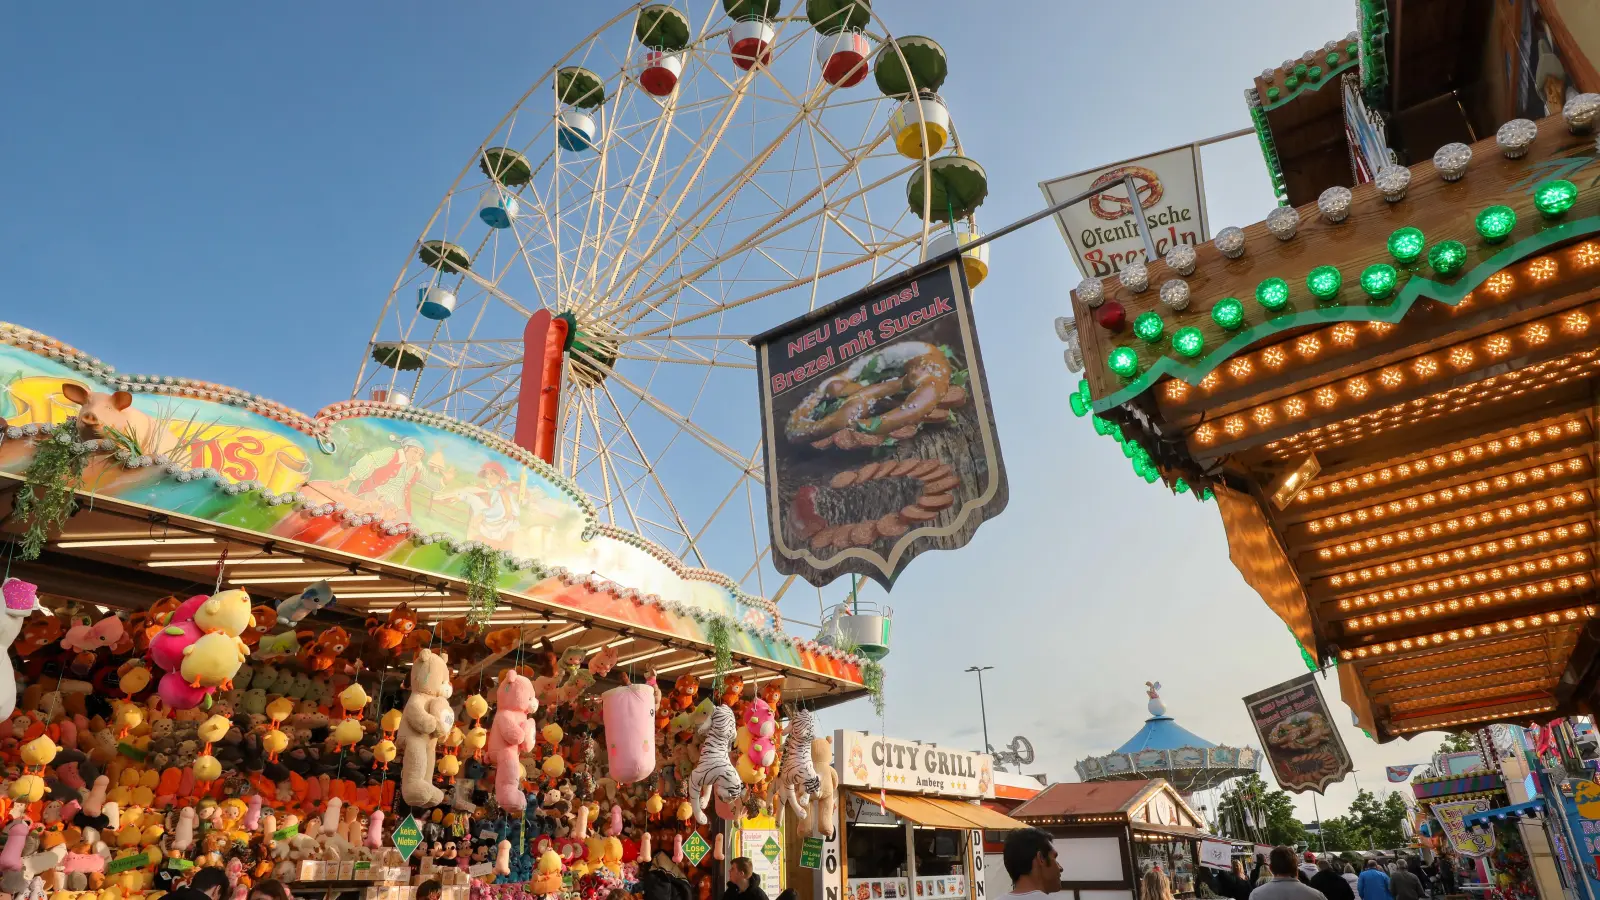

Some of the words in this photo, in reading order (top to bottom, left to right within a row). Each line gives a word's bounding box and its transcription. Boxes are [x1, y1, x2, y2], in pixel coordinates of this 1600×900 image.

[1081, 206, 1192, 249] Ofenfrsche
[1083, 226, 1198, 278] Breeln
[786, 324, 831, 358] NEU
[835, 308, 868, 336] bei
[872, 281, 921, 315] uns!
[770, 345, 836, 395] Brezel
[838, 329, 876, 361] mit
[879, 295, 953, 340] Sucuk
[871, 741, 920, 771] CITY
[924, 749, 977, 778] GRILL
[915, 775, 945, 791] Amberg
[400, 827, 417, 836] keine
[397, 837, 418, 846] Nieten
[685, 844, 705, 853] Lose
[690, 836, 700, 845] 20
[690, 852, 701, 861] 5€
